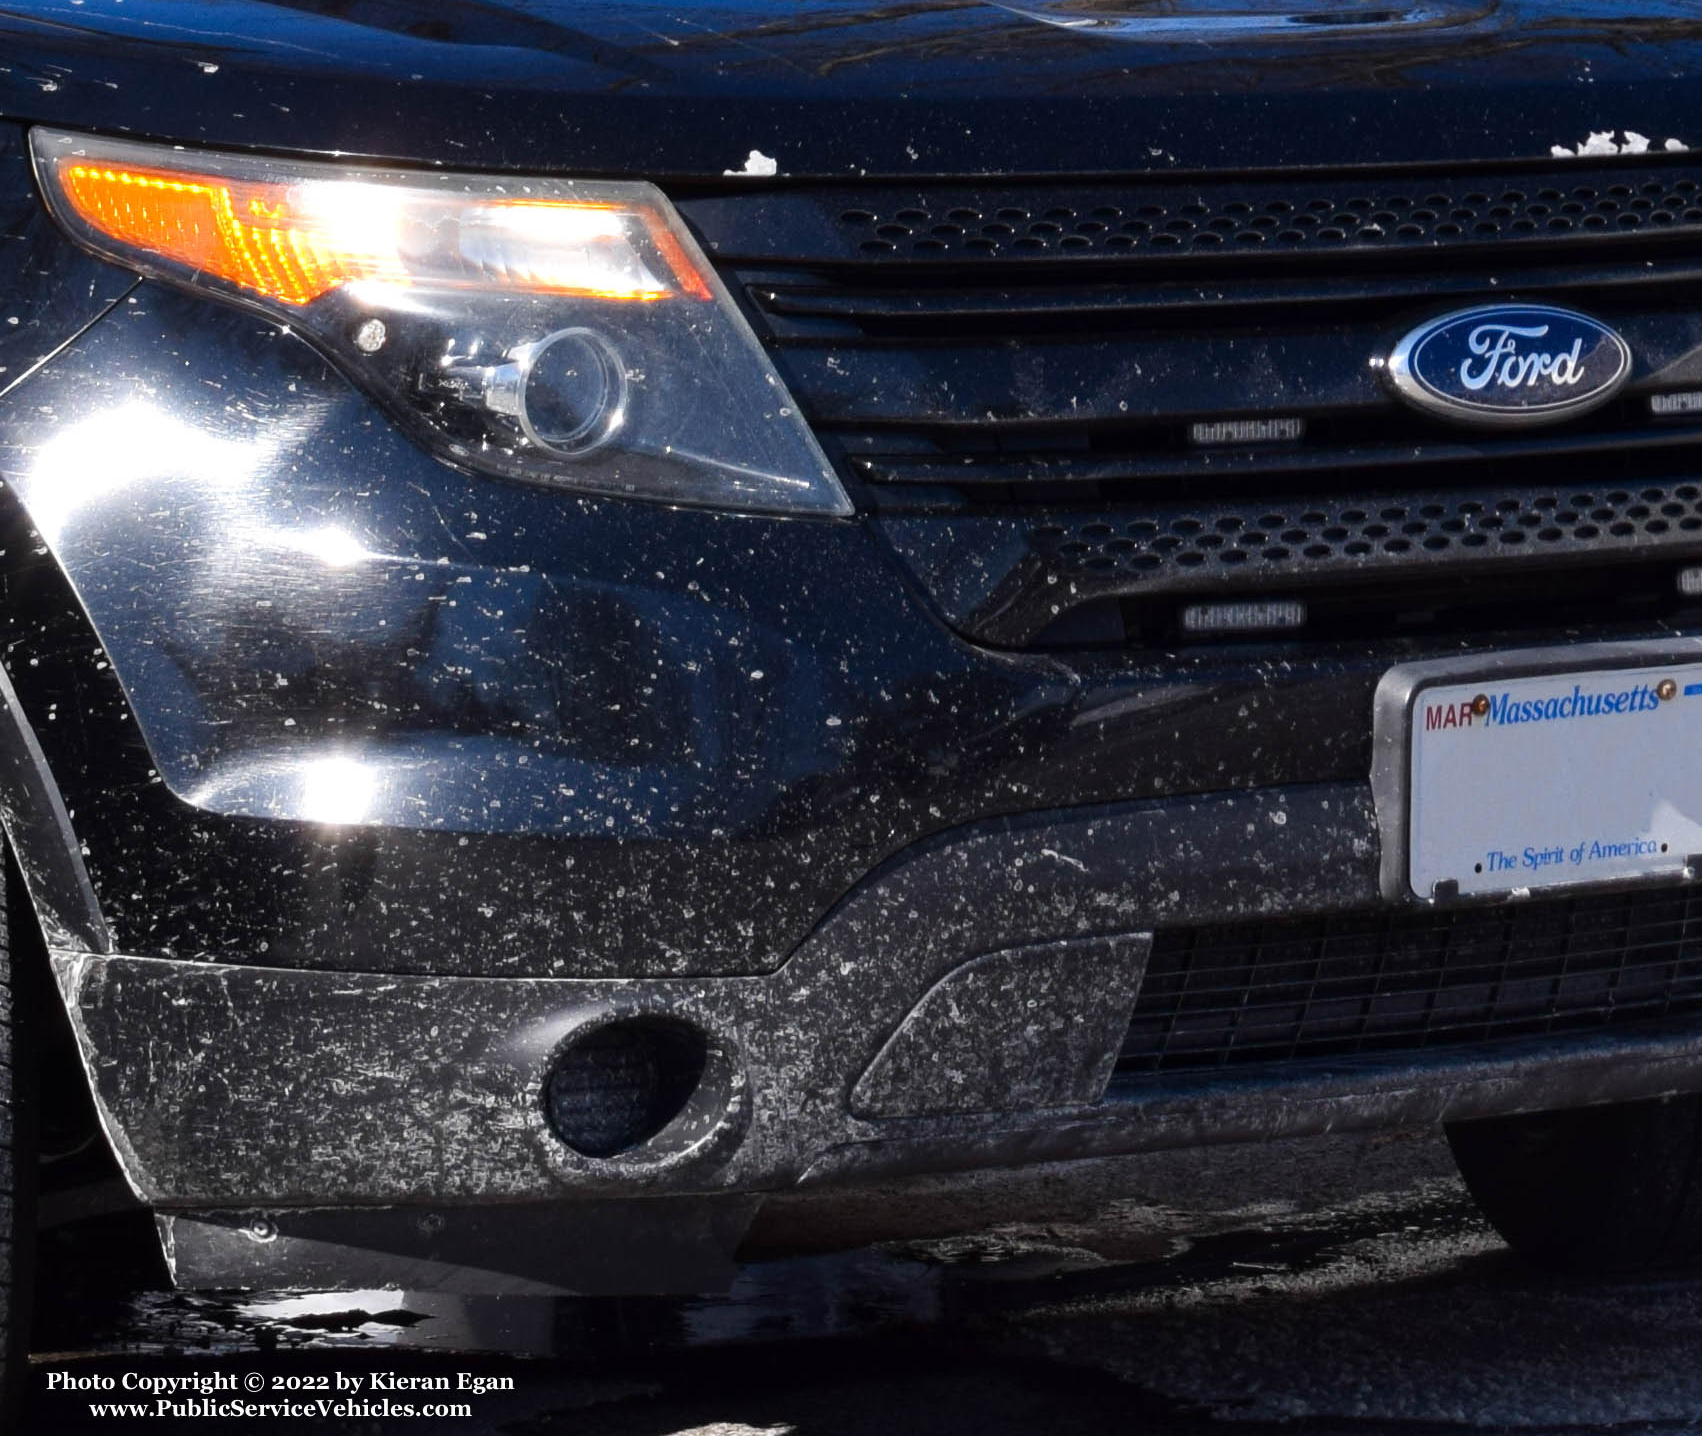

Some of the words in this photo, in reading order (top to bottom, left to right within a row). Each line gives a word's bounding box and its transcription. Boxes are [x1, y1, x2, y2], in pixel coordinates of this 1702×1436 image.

[1460, 324, 1585, 390] Ford
[1425, 702, 1474, 731] MAR
[1484, 684, 1660, 727] Massachusetts
[1487, 851, 1518, 872] The
[1522, 846, 1565, 871] Spirit
[1570, 840, 1588, 866] of
[1588, 837, 1658, 861] America
